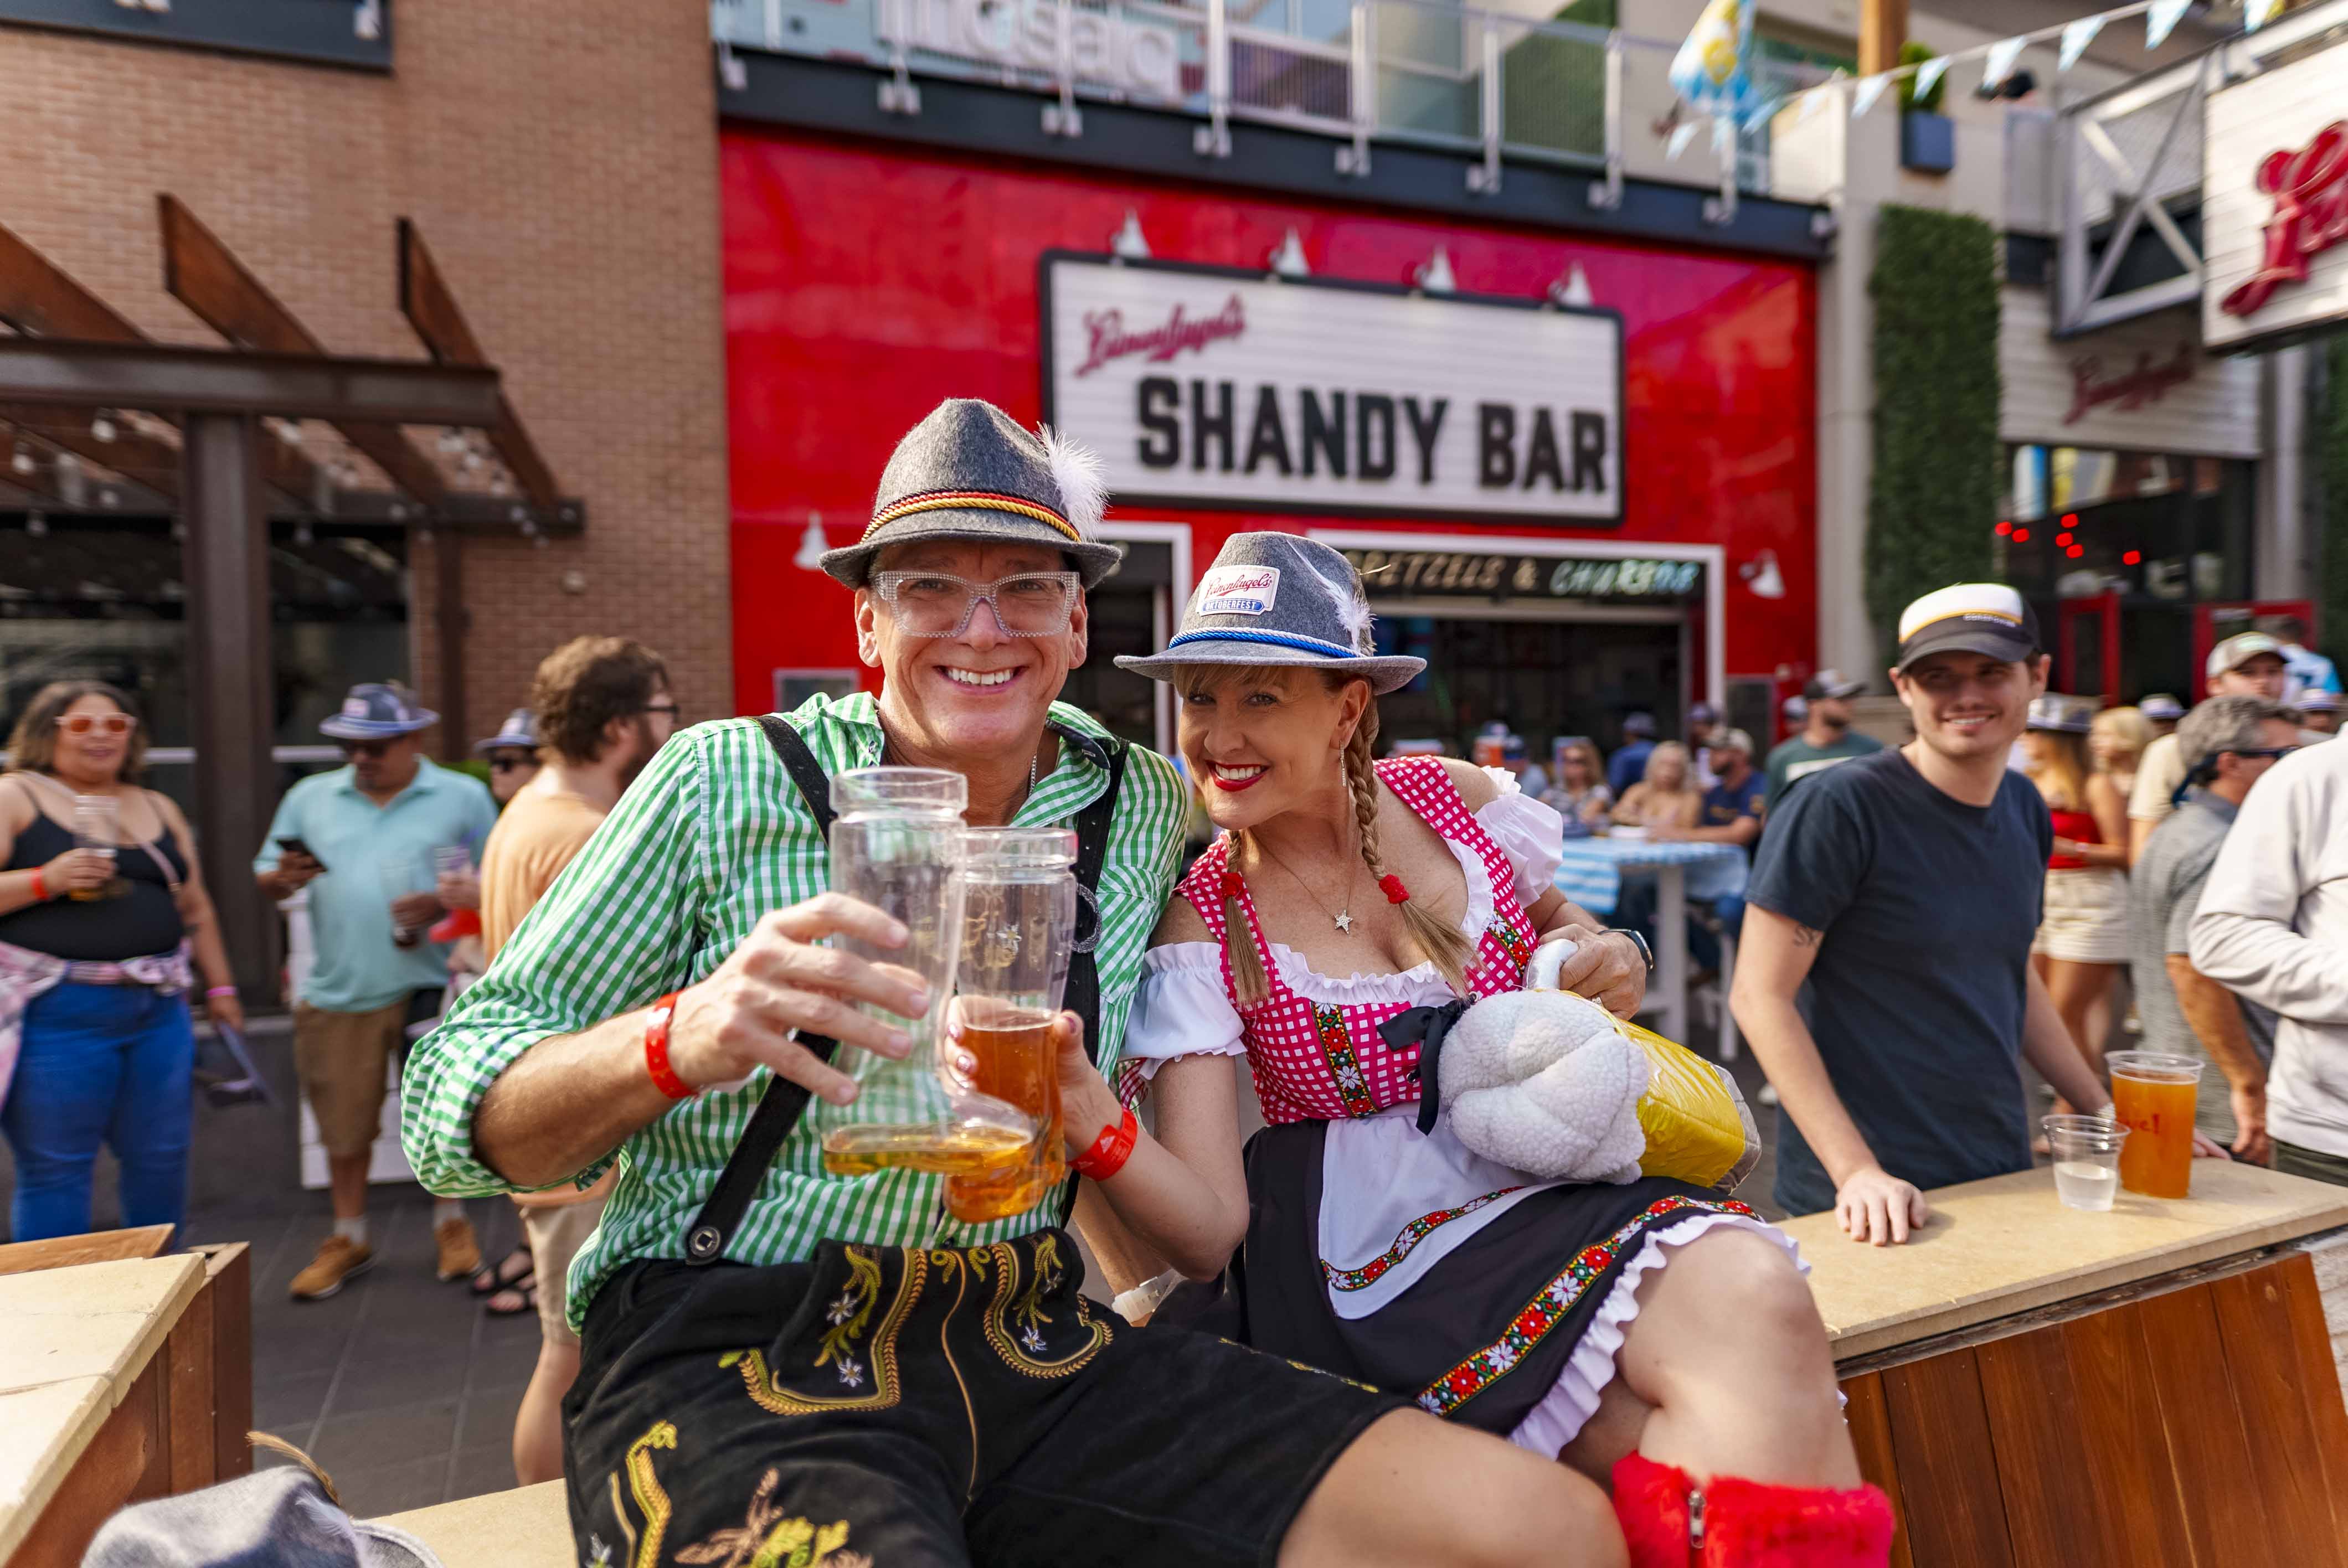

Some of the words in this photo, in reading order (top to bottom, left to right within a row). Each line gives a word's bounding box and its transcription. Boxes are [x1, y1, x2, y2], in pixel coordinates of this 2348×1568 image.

[1136, 375, 1449, 486] SHANDY
[1478, 403, 1608, 495] BAR
[1513, 557, 1539, 591] &
[1206, 600, 1257, 610] OKTOBERFEST
